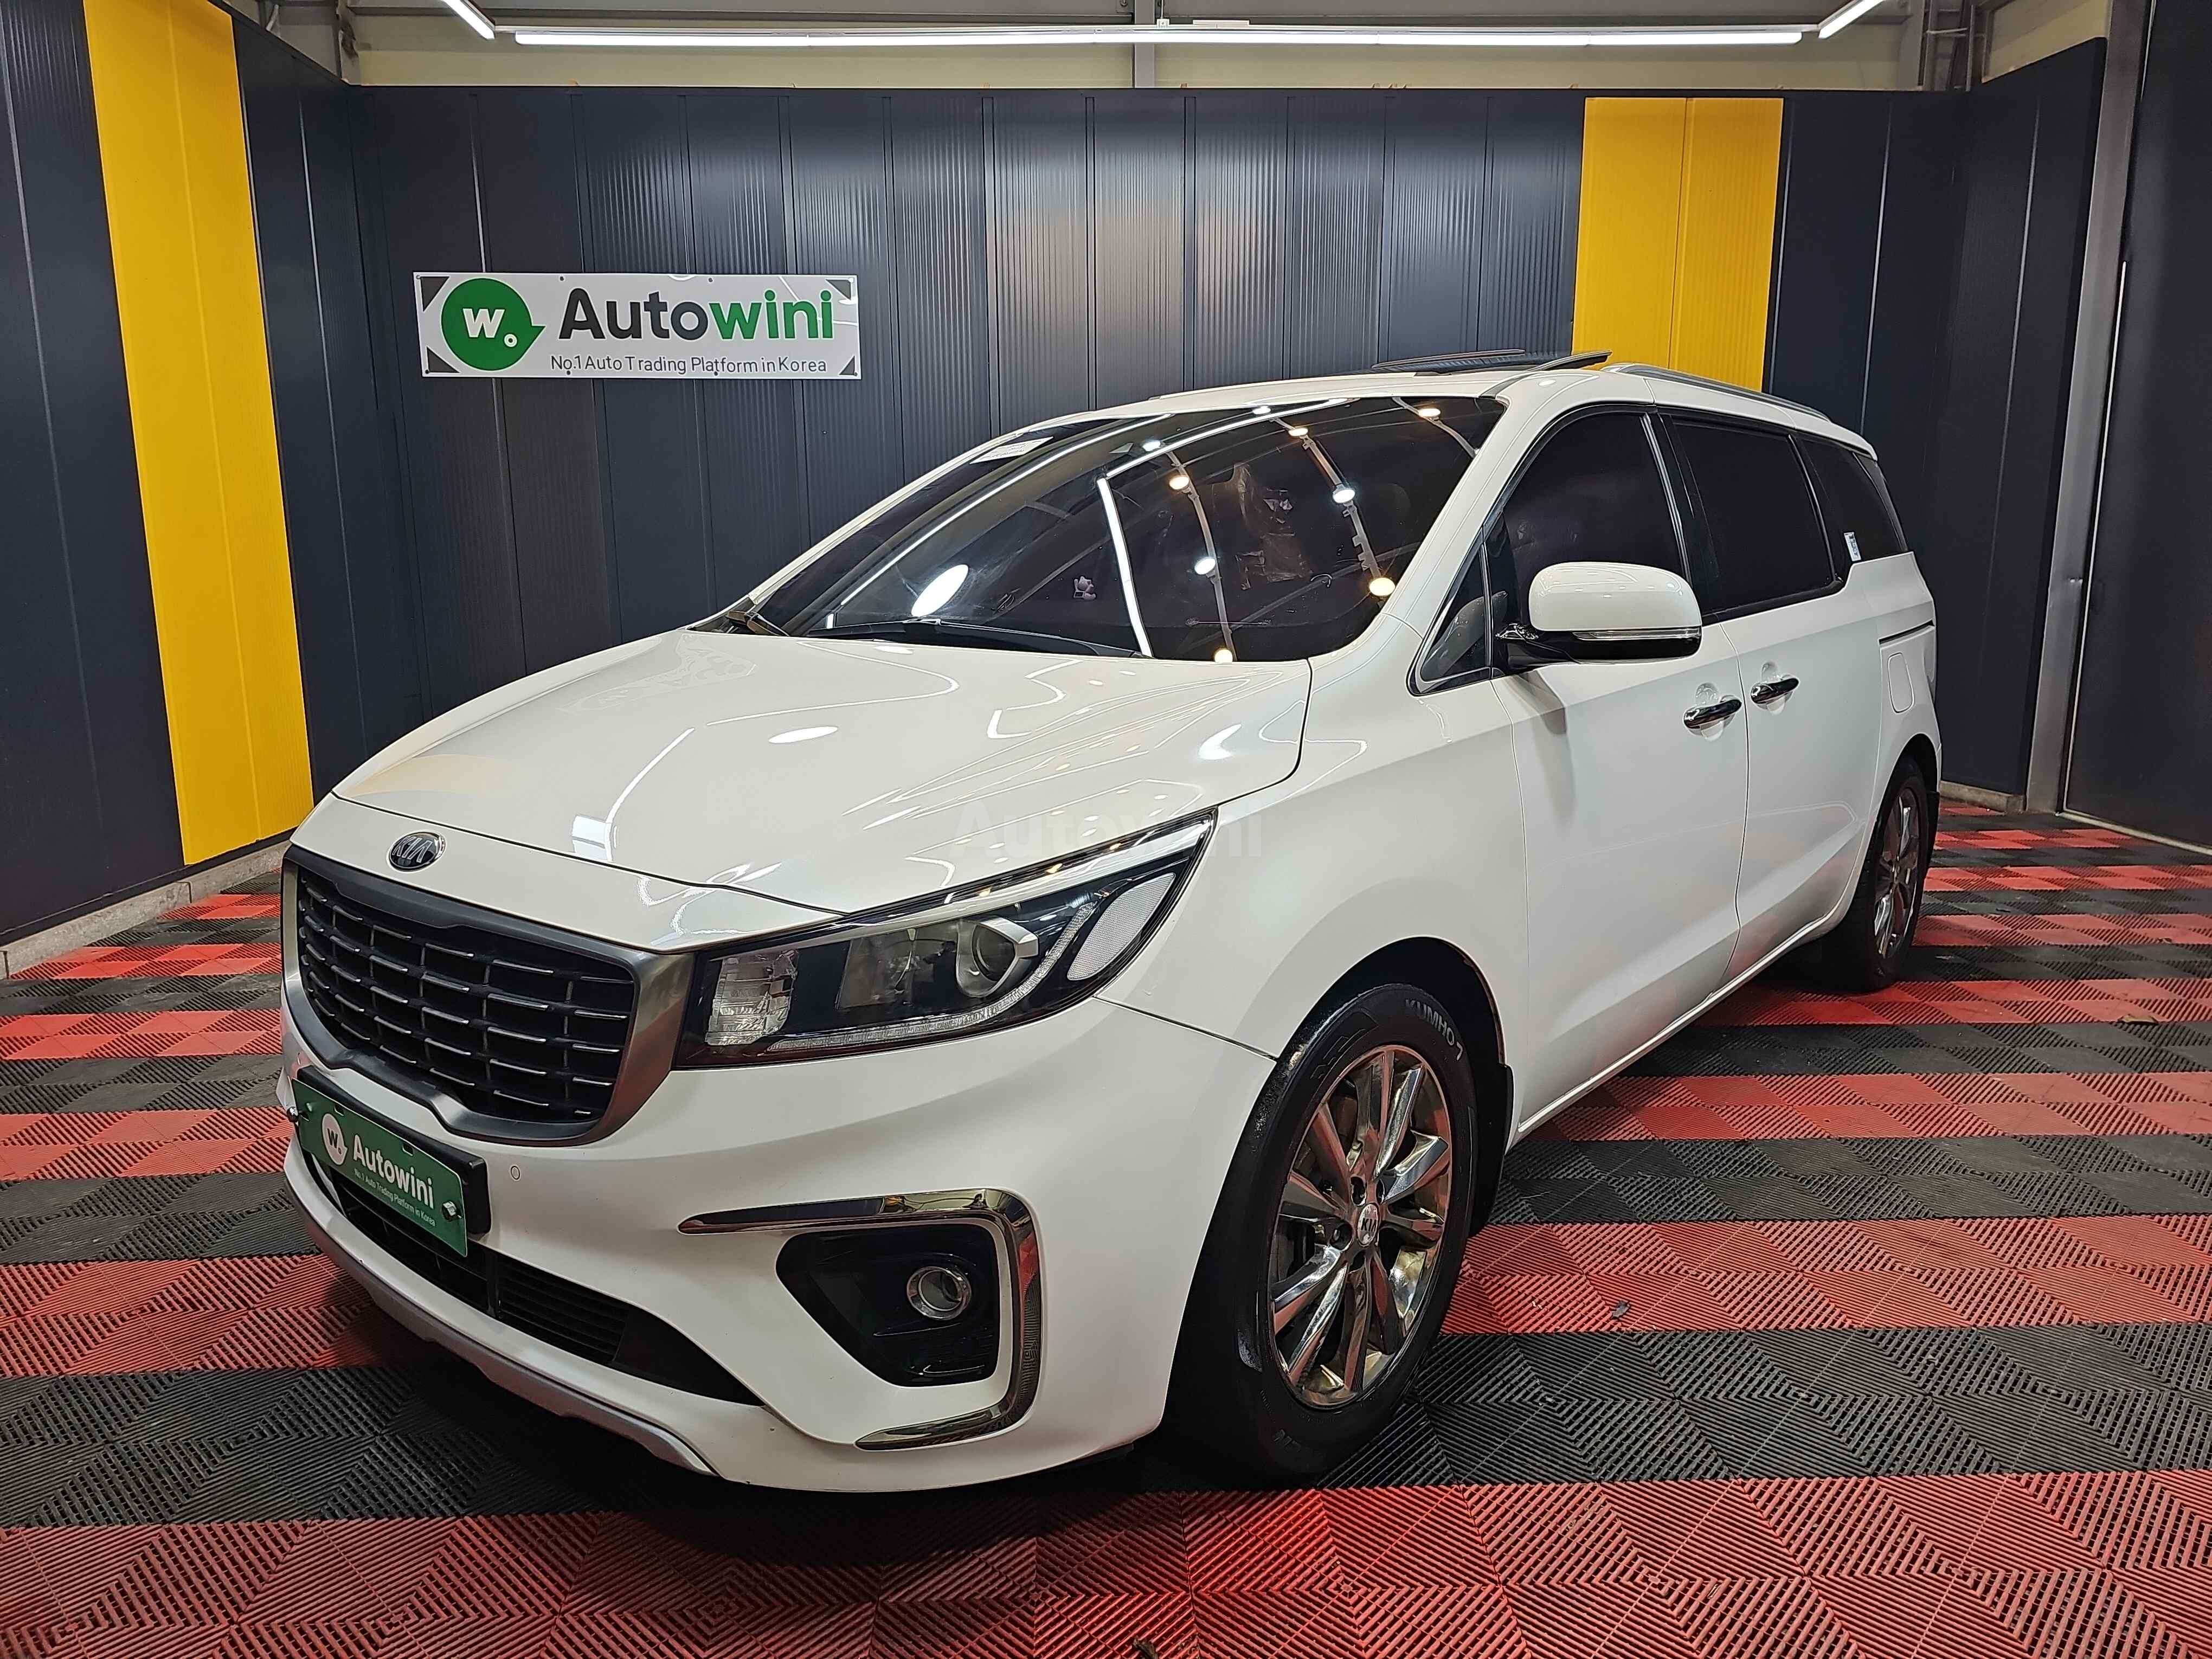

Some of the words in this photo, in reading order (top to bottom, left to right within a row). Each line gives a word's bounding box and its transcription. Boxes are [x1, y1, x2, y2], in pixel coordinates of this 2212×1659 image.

[558, 288, 833, 340] Autowini
[584, 356, 622, 370] Auto
[625, 356, 686, 374] Trading
[691, 357, 758, 372] Platform
[761, 357, 775, 372] in
[779, 357, 826, 372] Korea
[392, 836, 433, 863] KIA
[353, 1134, 434, 1210] Autowini
